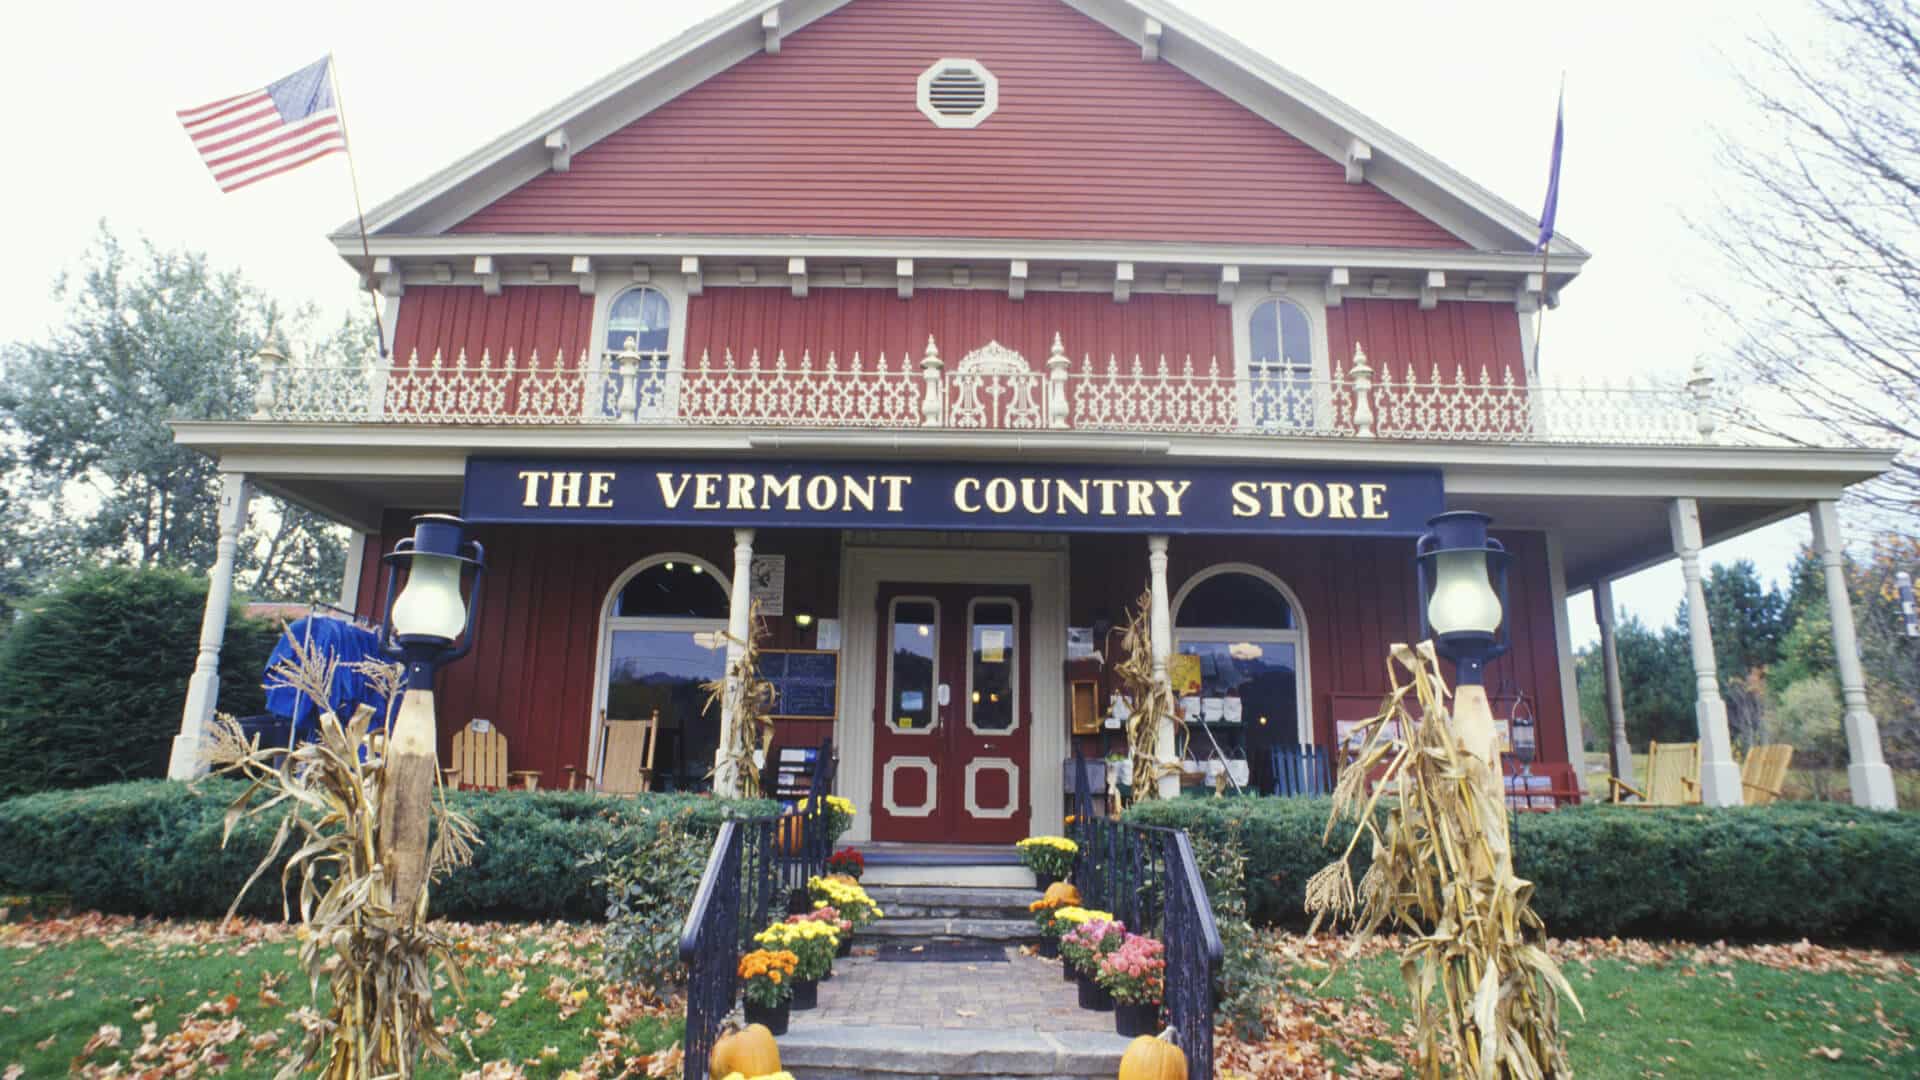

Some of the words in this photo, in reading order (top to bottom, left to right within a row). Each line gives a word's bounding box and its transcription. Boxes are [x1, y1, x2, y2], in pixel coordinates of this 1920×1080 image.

[518, 471, 616, 508] THE
[655, 472, 912, 512] VERMONT
[954, 477, 1192, 516] COUNTRY
[1231, 481, 1390, 519] STORE
